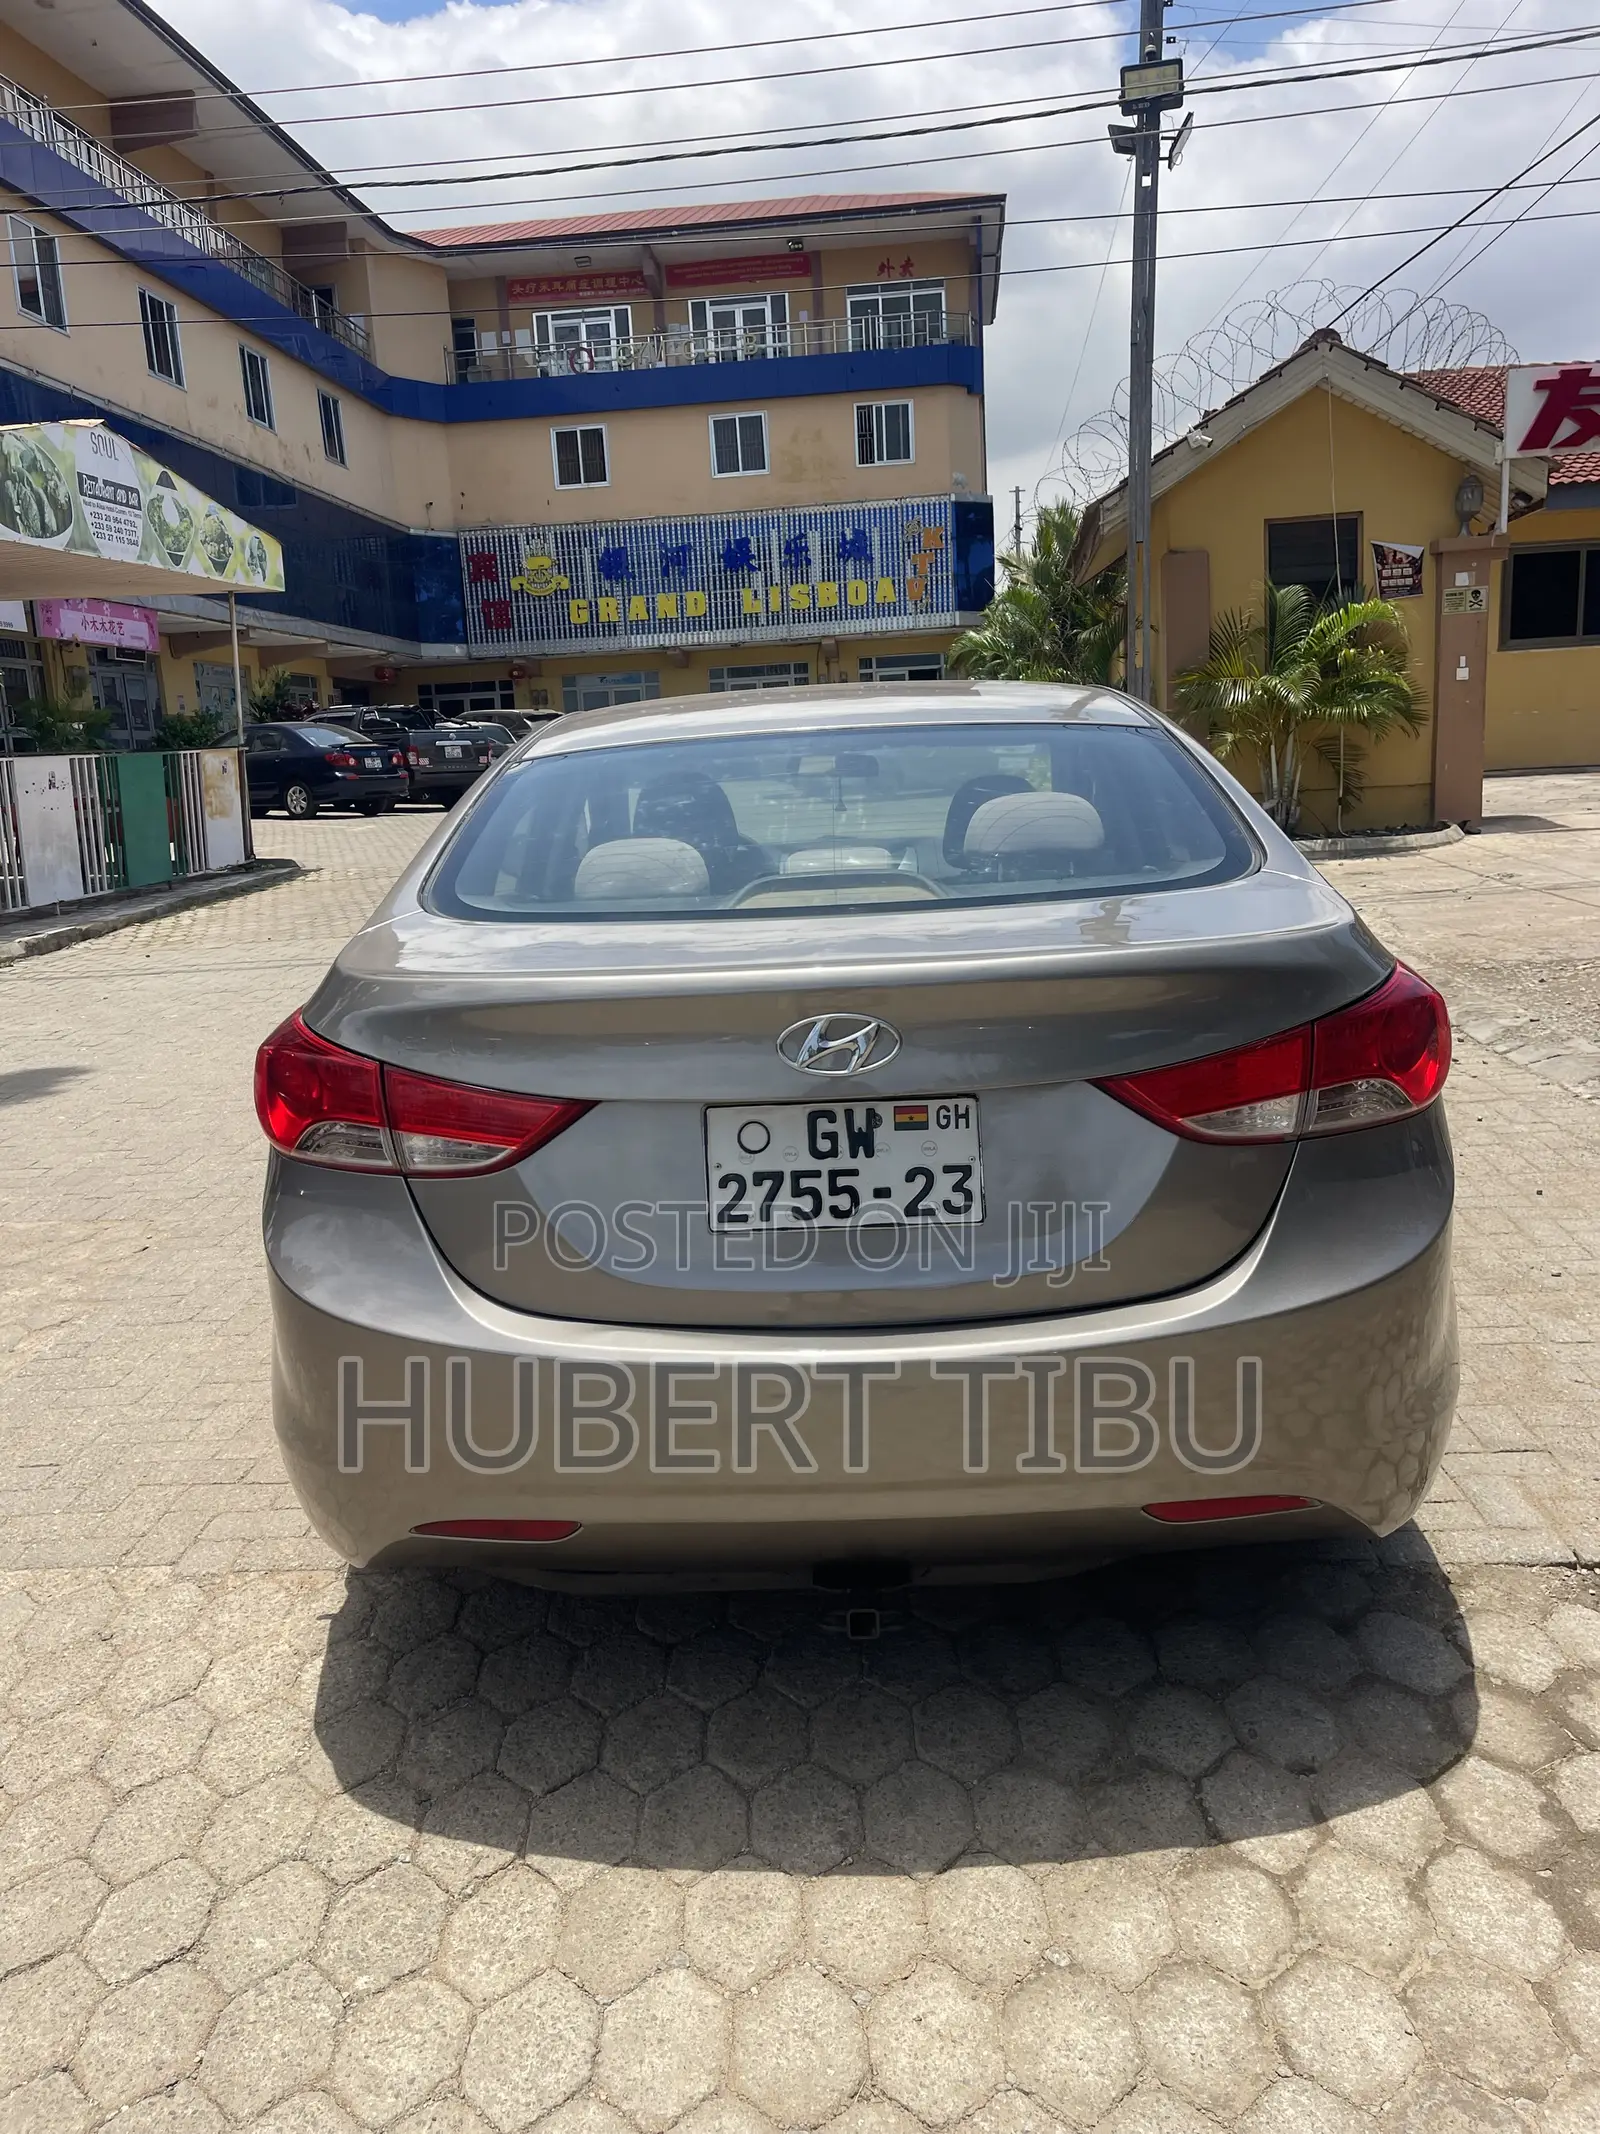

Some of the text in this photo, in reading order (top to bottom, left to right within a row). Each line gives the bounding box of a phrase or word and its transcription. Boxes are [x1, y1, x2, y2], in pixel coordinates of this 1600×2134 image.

[90, 431, 119, 461] SOUL
[90, 511, 103, 521] +233
[91, 521, 104, 531] +233
[92, 531, 106, 540] +233
[569, 577, 897, 624] GRAND LISBOA
[807, 1103, 970, 1160] GW GH
